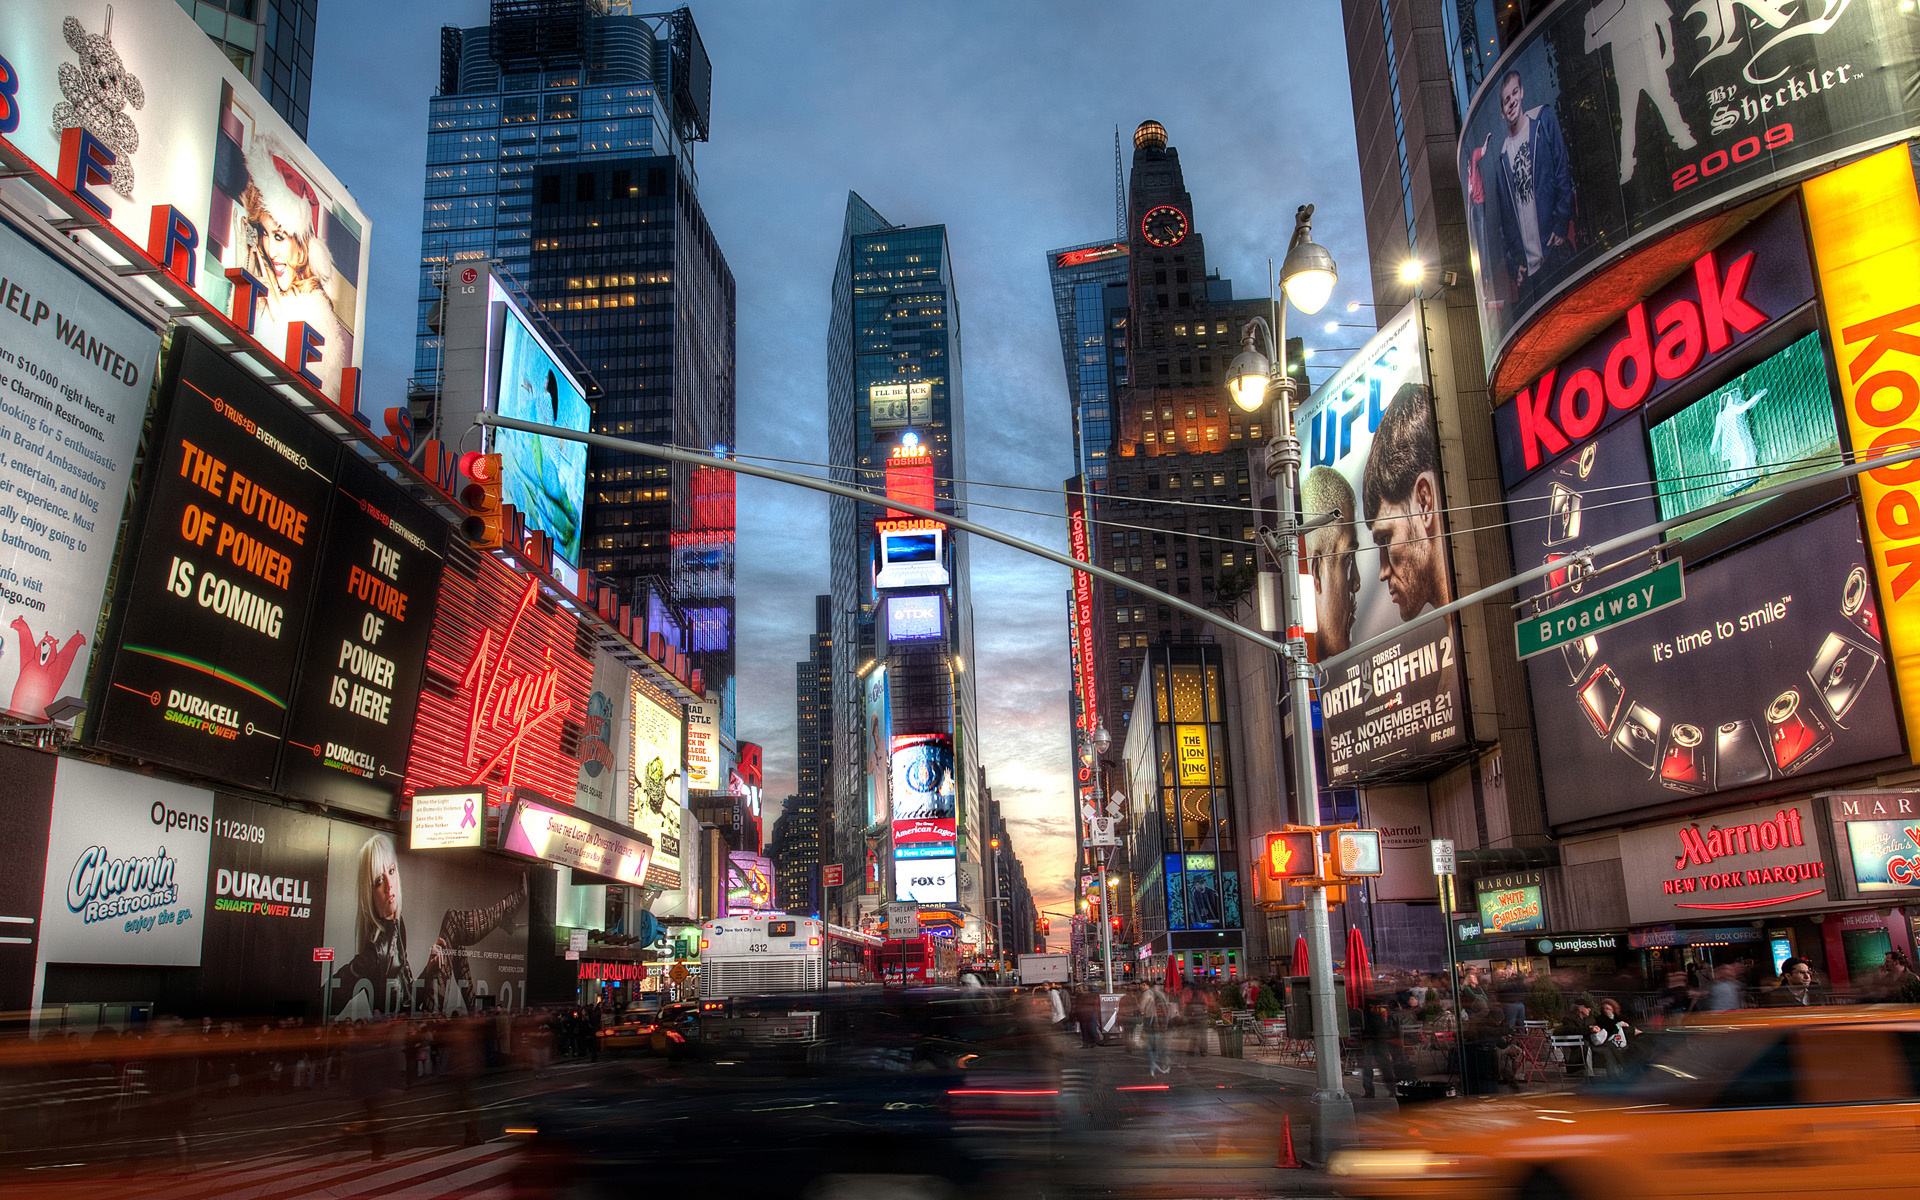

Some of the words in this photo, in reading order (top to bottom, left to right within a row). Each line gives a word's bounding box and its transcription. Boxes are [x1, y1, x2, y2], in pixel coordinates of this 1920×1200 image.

[1707, 83, 1737, 109] By
[1673, 123, 1794, 192] 2009
[461, 286, 475, 294] LG
[56, 313, 139, 387] WANTED
[1515, 251, 1768, 471] Kodak
[17, 356, 58, 388] $10,000
[60, 385, 83, 405] right
[84, 396, 104, 417] here
[106, 412, 116, 425] at
[875, 389, 890, 397] I'LL
[892, 388, 904, 396] BE
[1297, 397, 1326, 426] ULTIMATE
[1327, 372, 1356, 400] FIGHTING
[1310, 346, 1397, 468] UFC
[11, 379, 53, 411] Charmin
[55, 404, 105, 442] Restrooms.
[39, 420, 54, 436] for
[55, 430, 62, 442] 5
[64, 434, 117, 471] enthusiastic
[255, 428, 300, 466] EVERYWHERE
[887, 457, 932, 466] TOSHIBA
[893, 446, 925, 458] 2009
[13, 435, 45, 457] Brand
[46, 450, 107, 490] Ambassadors
[10, 460, 58, 492] entertain,
[60, 484, 77, 500] and
[79, 490, 99, 514] blog
[180, 439, 227, 498] THE
[227, 471, 308, 546] FUTURE
[16, 487, 70, 521] experience.
[72, 513, 95, 533] Must
[20, 515, 48, 536] enjoy
[49, 528, 75, 550] going
[77, 537, 87, 553] to
[389, 518, 420, 548] EVERYWHERE
[875, 520, 947, 534] TOSHIBA
[1, 529, 52, 562] bathroom.
[181, 504, 216, 546] OF
[216, 522, 292, 590] POWER
[372, 538, 401, 581] THE
[1072, 510, 1089, 602] Macovision
[23, 575, 43, 592] visit
[166, 556, 195, 599] IS
[197, 571, 284, 639] COMING
[348, 564, 408, 622] FUTURE
[361, 612, 385, 645] OF
[905, 608, 934, 619] TDK
[1080, 603, 1090, 625] for
[1539, 584, 1655, 643] Broadway
[1083, 625, 1093, 672] name
[1372, 643, 1401, 668] FORREST
[1653, 641, 1673, 663] it's
[1675, 630, 1712, 654] time
[1716, 620, 1735, 640] to
[338, 639, 395, 690] POWER
[1347, 664, 1360, 680] TITO
[1372, 641, 1439, 698] GRIFFIN
[1440, 636, 1454, 669] 2
[329, 675, 348, 708] IS
[350, 683, 392, 725] HERE
[463, 577, 570, 790] Virgin
[1086, 675, 1095, 711] new
[1322, 677, 1363, 719] ORTIZ
[167, 689, 240, 728] DURACELL
[1330, 732, 1355, 751] SAT.
[1357, 700, 1432, 741] NOVEMBER
[1435, 690, 1452, 711] 21
[1184, 736, 1201, 744] THE
[1331, 747, 1353, 764] LIVE
[1355, 739, 1370, 754] ON
[1373, 708, 1453, 749] PAY-PER-VIEW
[1430, 725, 1456, 743] UFC.COM
[325, 742, 375, 771] DURACELL
[1181, 747, 1204, 761] LION
[1182, 763, 1206, 778] KING
[362, 770, 375, 779] LAB
[588, 785, 603, 799] SQUARE
[150, 801, 209, 833] Opens
[214, 819, 265, 844] 11/23/09
[547, 817, 562, 833] SHINE
[562, 826, 572, 836] THE
[572, 827, 586, 842] LIGHT
[586, 834, 593, 844] ON
[593, 833, 615, 851] DOMESTIC
[615, 840, 633, 858] VIOLENCE
[895, 826, 931, 839] American
[933, 826, 955, 838] Lager
[1380, 825, 1421, 837] Marriott
[1675, 807, 1805, 870] Marriott
[661, 836, 678, 851] CIRCA
[920, 848, 953, 856] Corporation
[1873, 839, 1913, 860] Berlin's
[67, 846, 177, 914] Charmin
[216, 868, 312, 905] DURACELL
[911, 877, 934, 886] FOX
[937, 876, 945, 886] 5
[1477, 872, 1540, 890] MARQUIS
[1663, 878, 1696, 895] NEW
[1700, 871, 1743, 890] YORK
[84, 884, 179, 924] Restrooms!
[290, 907, 311, 919] LAB
[1498, 890, 1525, 907] WHITE
[124, 914, 156, 934] enjoy
[157, 910, 176, 926] the
[176, 907, 193, 926] go.
[895, 916, 911, 924] MUST
[1492, 901, 1539, 930] CHRISTMAS
[1842, 917, 1855, 925] THE
[1855, 915, 1882, 925] MUSICAL
[749, 944, 768, 952] 4312
[1554, 939, 1598, 952] sunglass
[1598, 936, 1616, 949] hut
[1715, 932, 1732, 941] BOX
[1733, 931, 1762, 941] OFFICE
[602, 963, 647, 980] HOLLYWOOD
